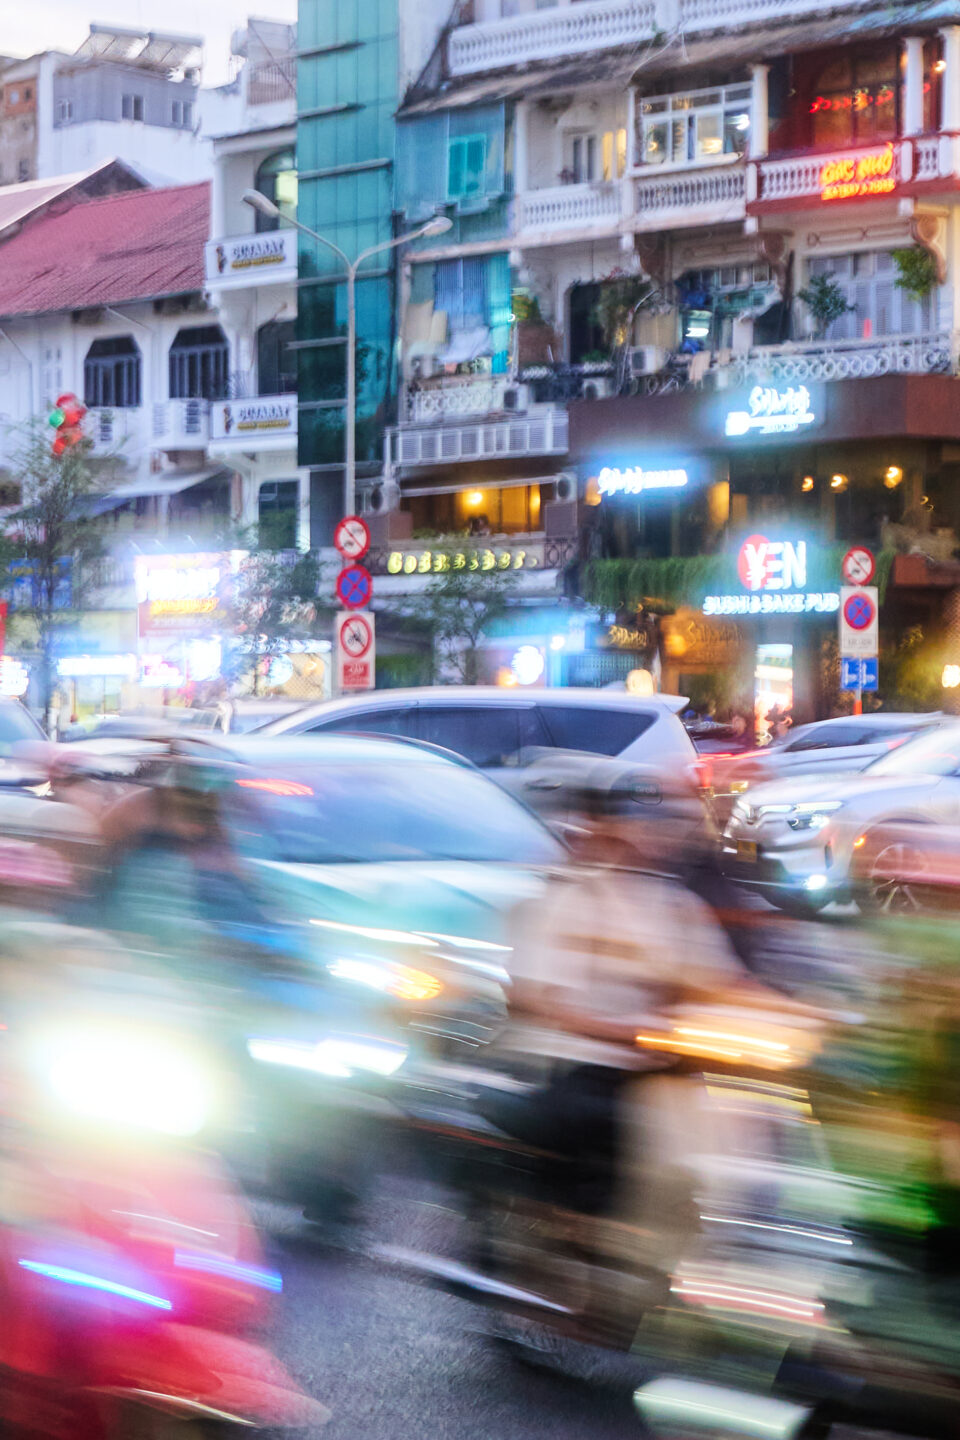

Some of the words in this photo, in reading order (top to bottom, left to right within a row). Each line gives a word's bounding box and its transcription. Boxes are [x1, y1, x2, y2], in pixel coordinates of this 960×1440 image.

[703, 596, 750, 615] SUSHI
[761, 594, 805, 613] SAKE
[805, 593, 840, 612] PUB
